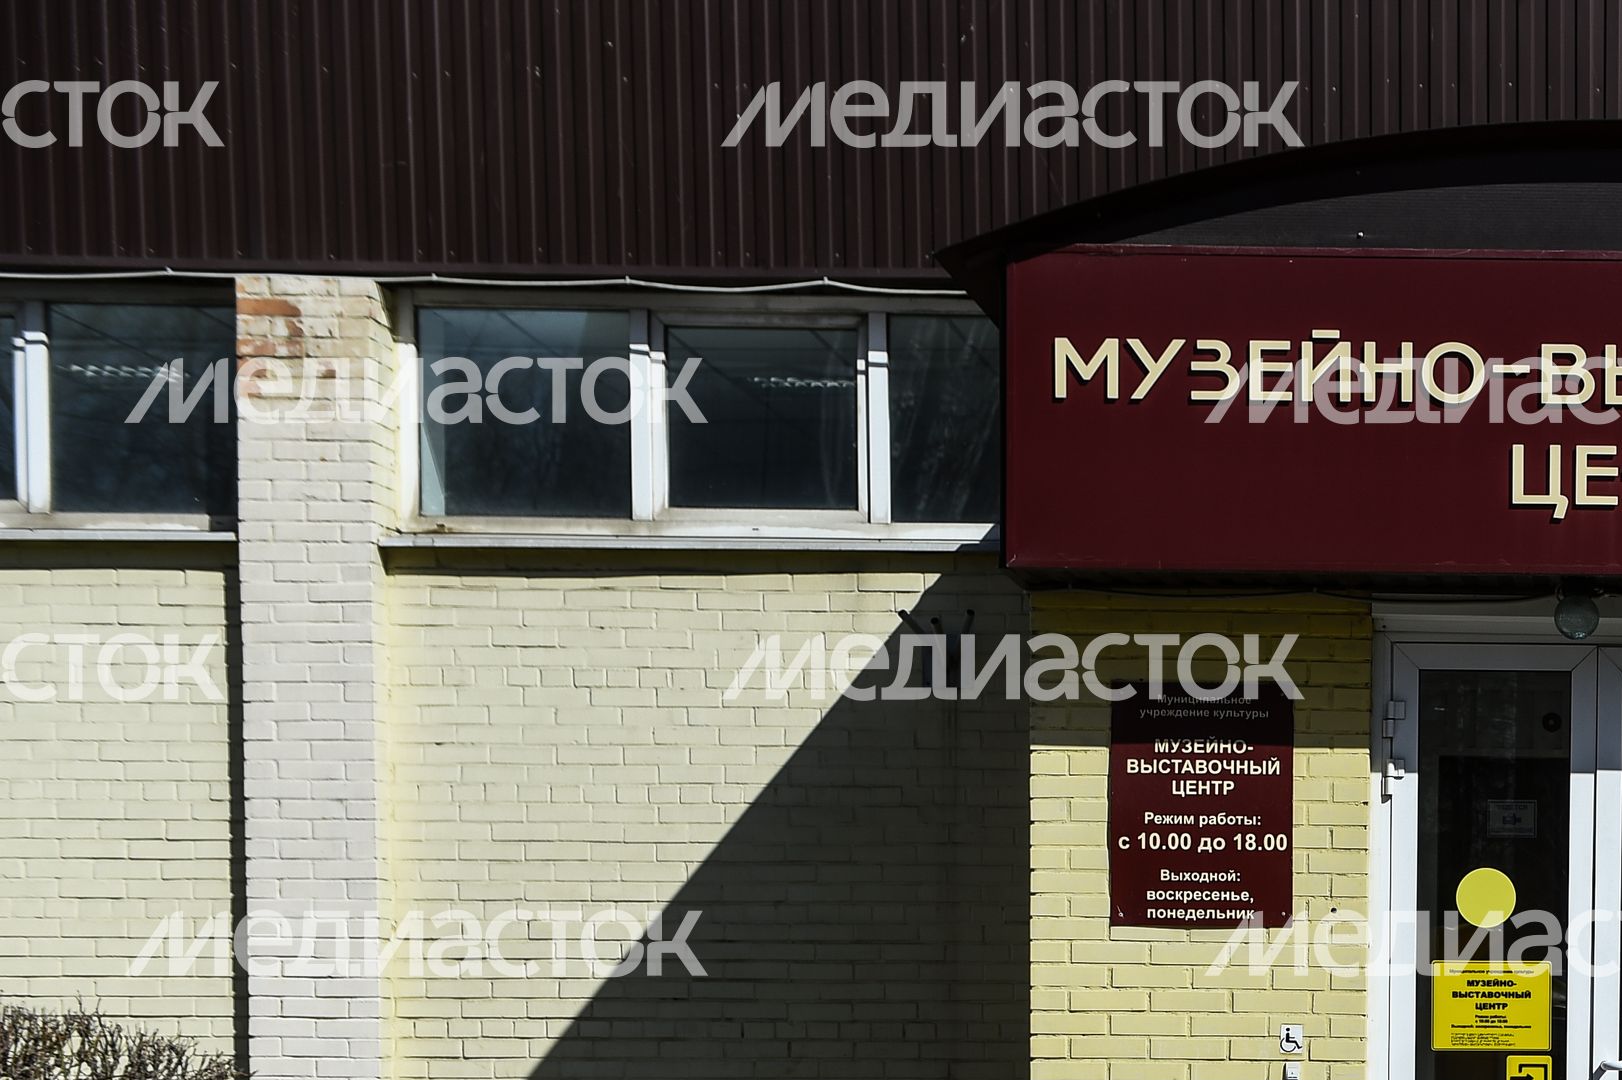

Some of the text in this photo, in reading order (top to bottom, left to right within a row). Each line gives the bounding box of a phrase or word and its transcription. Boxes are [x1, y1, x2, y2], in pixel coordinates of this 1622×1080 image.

[1139, 707, 1269, 719] учреждение культуры
[1154, 736, 1254, 754] МУЗЕЙНО-
[1126, 757, 1281, 776] ВЫСТАВОЧНЫЙ
[1171, 780, 1235, 797] ЦЕНТР
[1144, 812, 1262, 827] Режим работы:
[1118, 833, 1288, 853] с 10.00 до 18.00
[1160, 868, 1241, 883] Выходной:
[1146, 889, 1254, 904] воскресенье,
[1147, 908, 1255, 920] понедельник
[1466, 978, 1517, 987] МУЗЕЙНО-
[1451, 990, 1532, 999] ВЫСТАВОЧНЫЙ
[1475, 1002, 1509, 1011] ЦЕНТР
